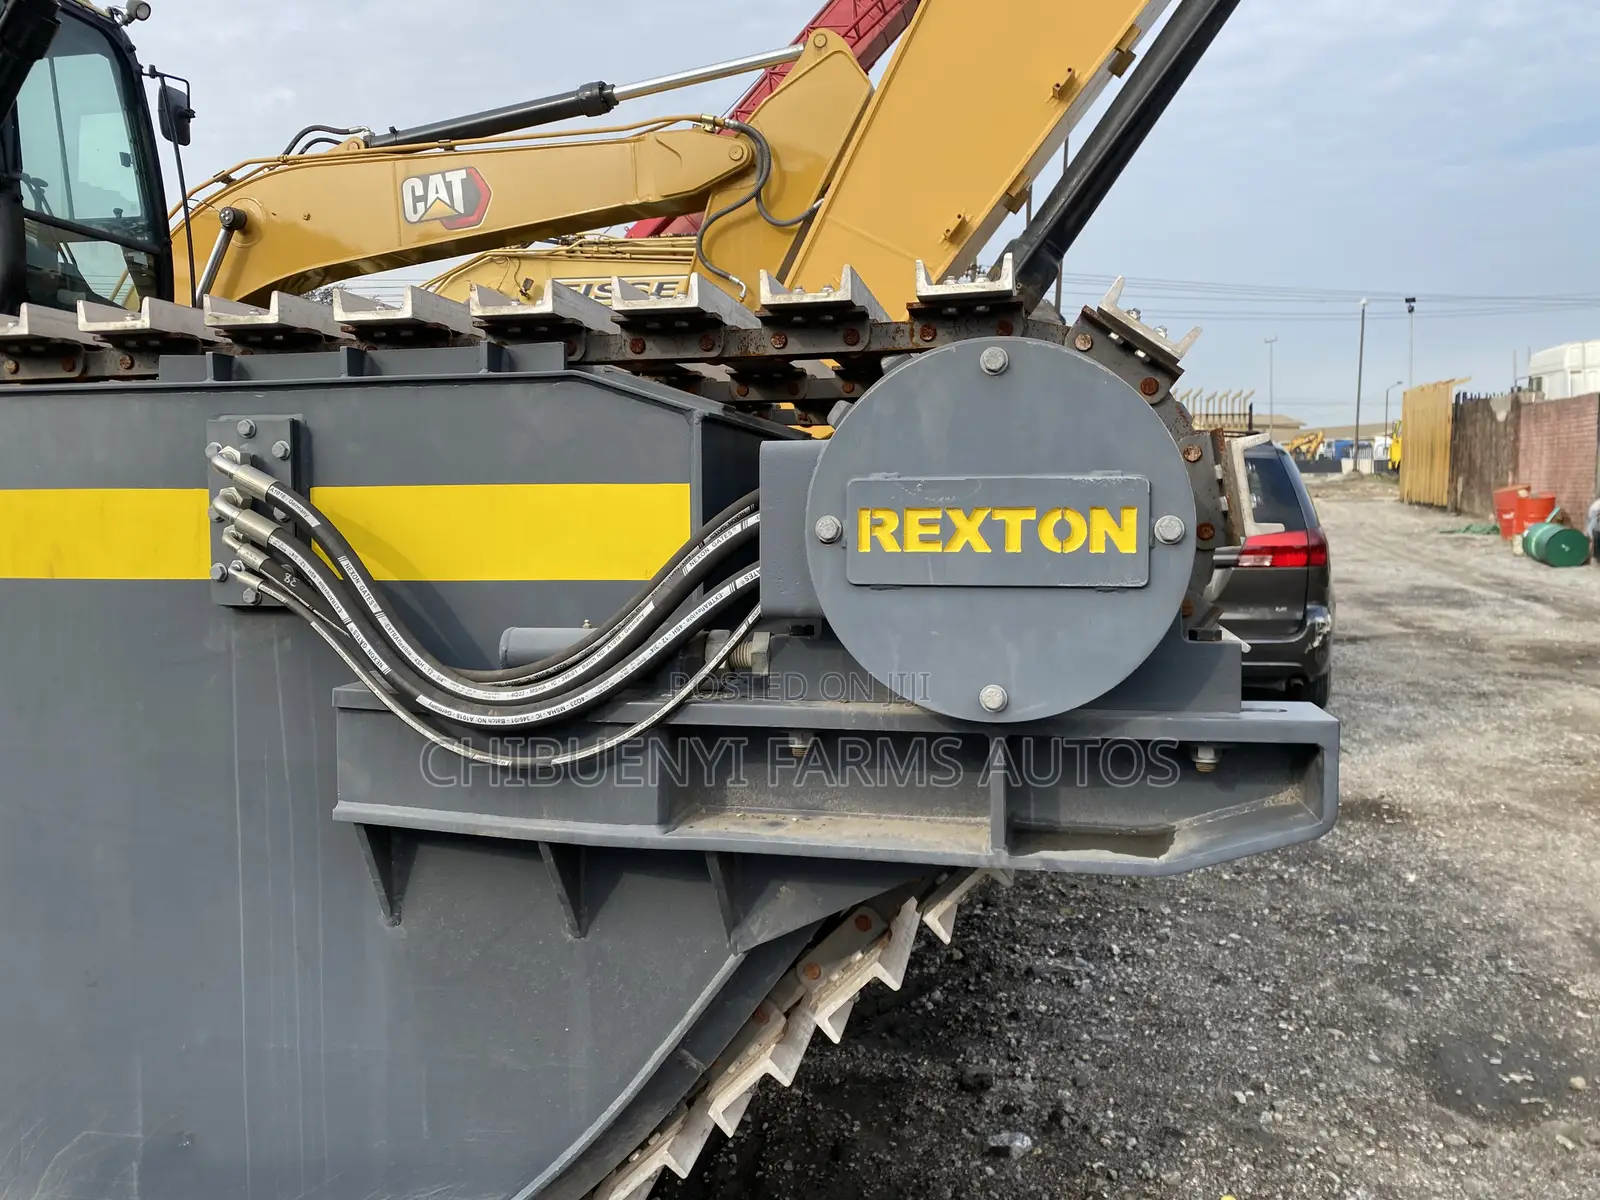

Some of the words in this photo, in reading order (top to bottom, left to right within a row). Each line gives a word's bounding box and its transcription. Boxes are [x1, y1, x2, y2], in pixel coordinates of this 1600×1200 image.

[402, 168, 467, 223] CAT
[857, 507, 1138, 553] REXTON
[687, 546, 710, 567] NEXON
[343, 561, 361, 584] NEXON
[365, 648, 385, 668] NEXON
[427, 700, 452, 717] Germany
[546, 704, 566, 716] MSHA
